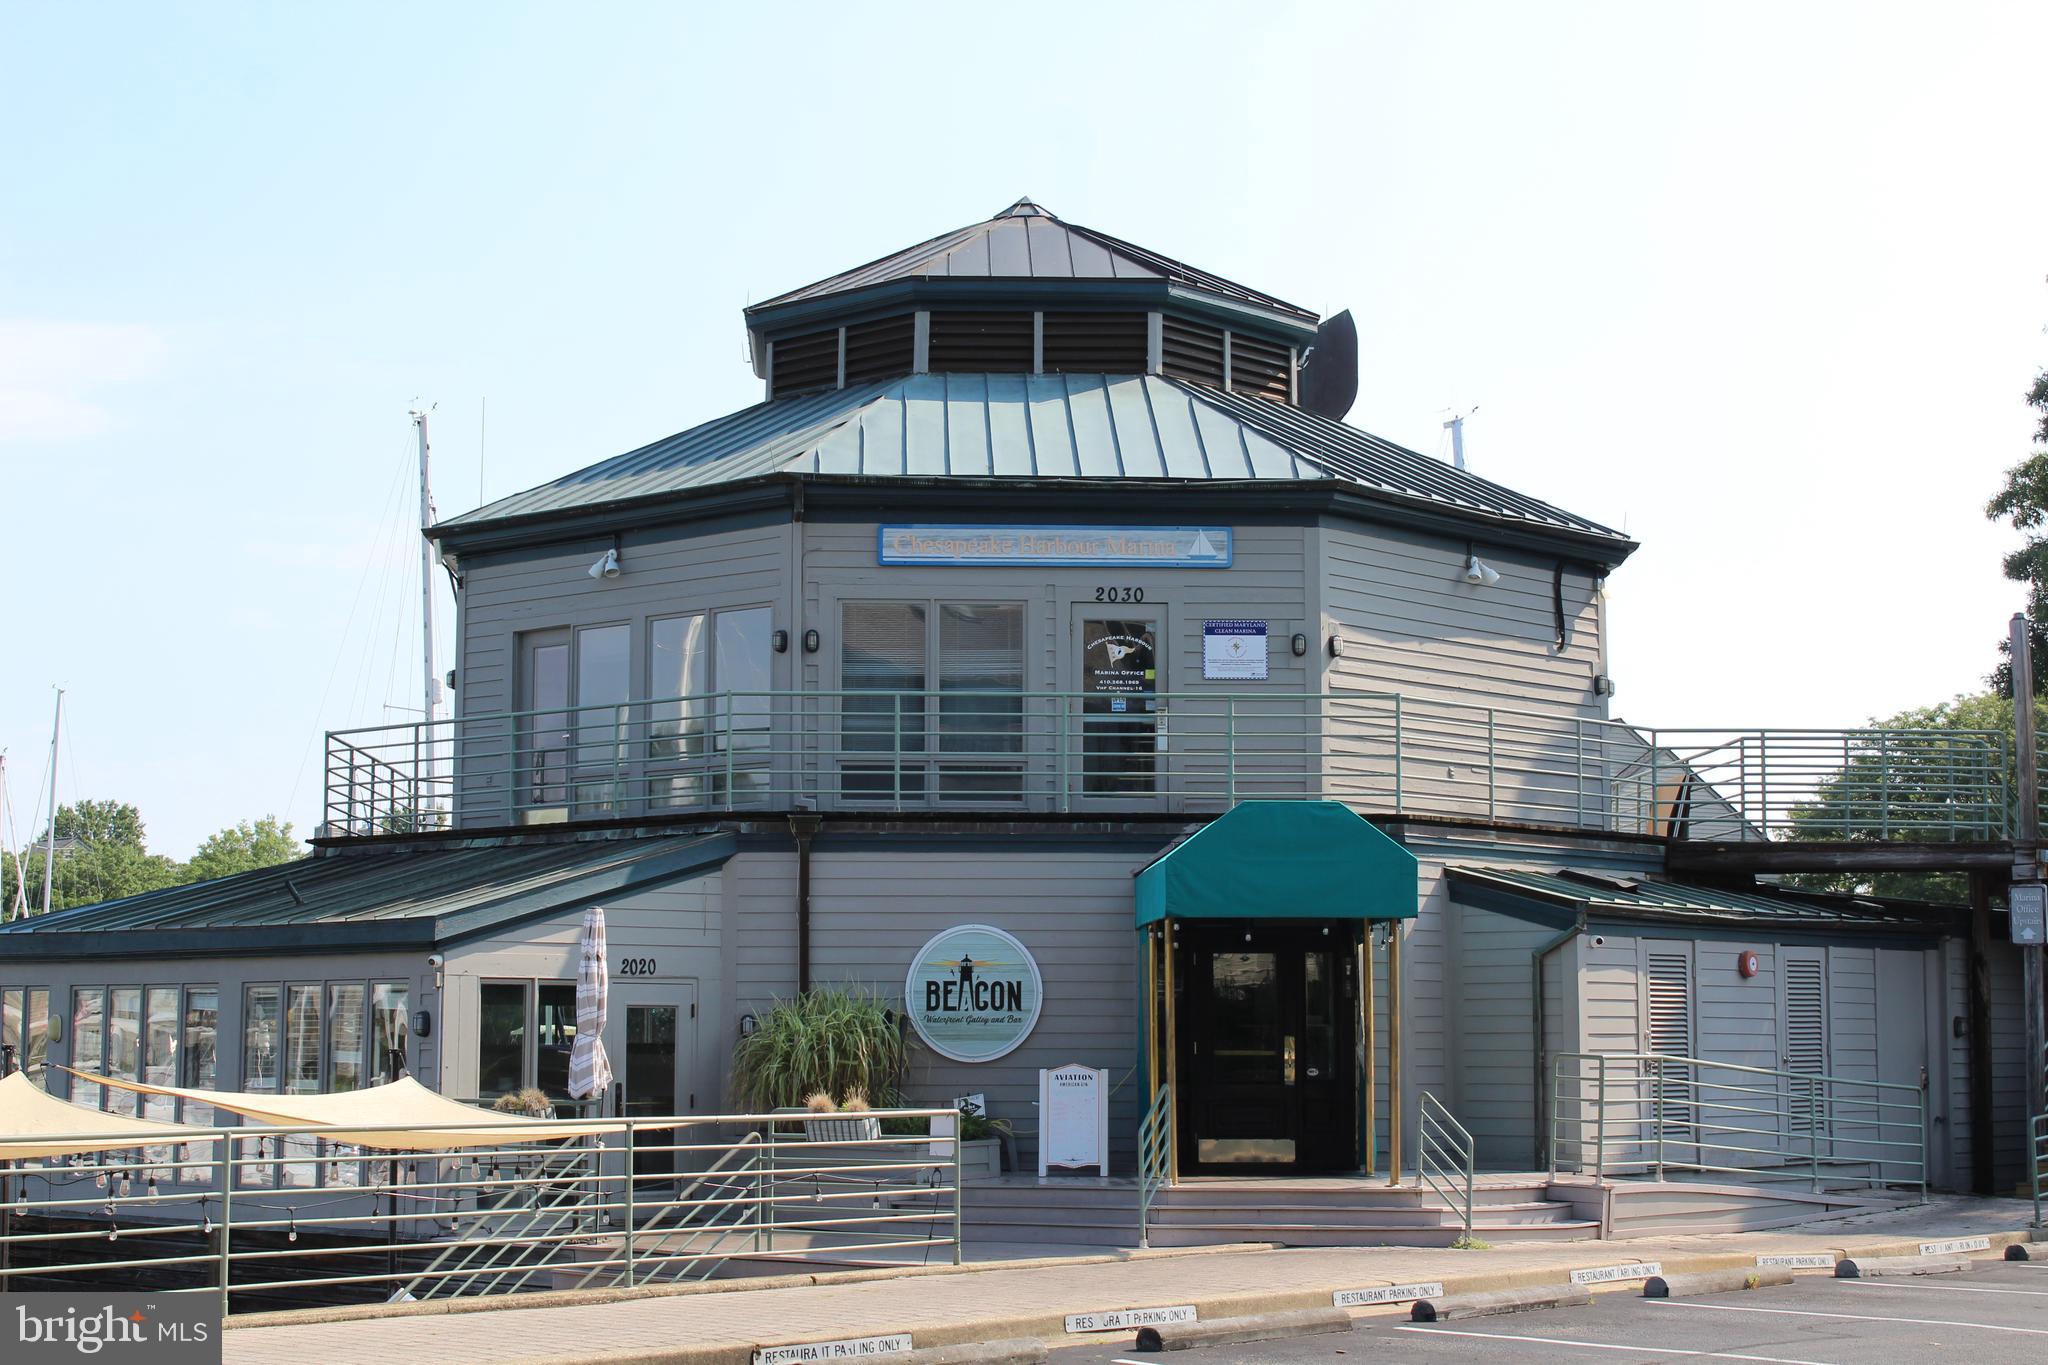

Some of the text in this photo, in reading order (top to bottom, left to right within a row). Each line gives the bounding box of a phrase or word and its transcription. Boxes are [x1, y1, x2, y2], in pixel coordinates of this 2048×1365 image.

[893, 534, 1177, 559] Chesapeake Harbour Marina
[1095, 586, 1144, 602] 2030
[1087, 635, 1152, 651] CHESAPEAKE HARBOUR
[2016, 904, 2040, 913] Office
[620, 958, 656, 976] 2020
[925, 979, 1022, 1013] BEACON
[923, 1013, 1023, 1026] Waterfront Galley and Bar
[1577, 1268, 1615, 1282] RESTAURANT
[1341, 1285, 1435, 1304] RESTAURANT PARKING ONLY
[1169, 1309, 1187, 1321] ONLY
[878, 1338, 901, 1353] ONLY
